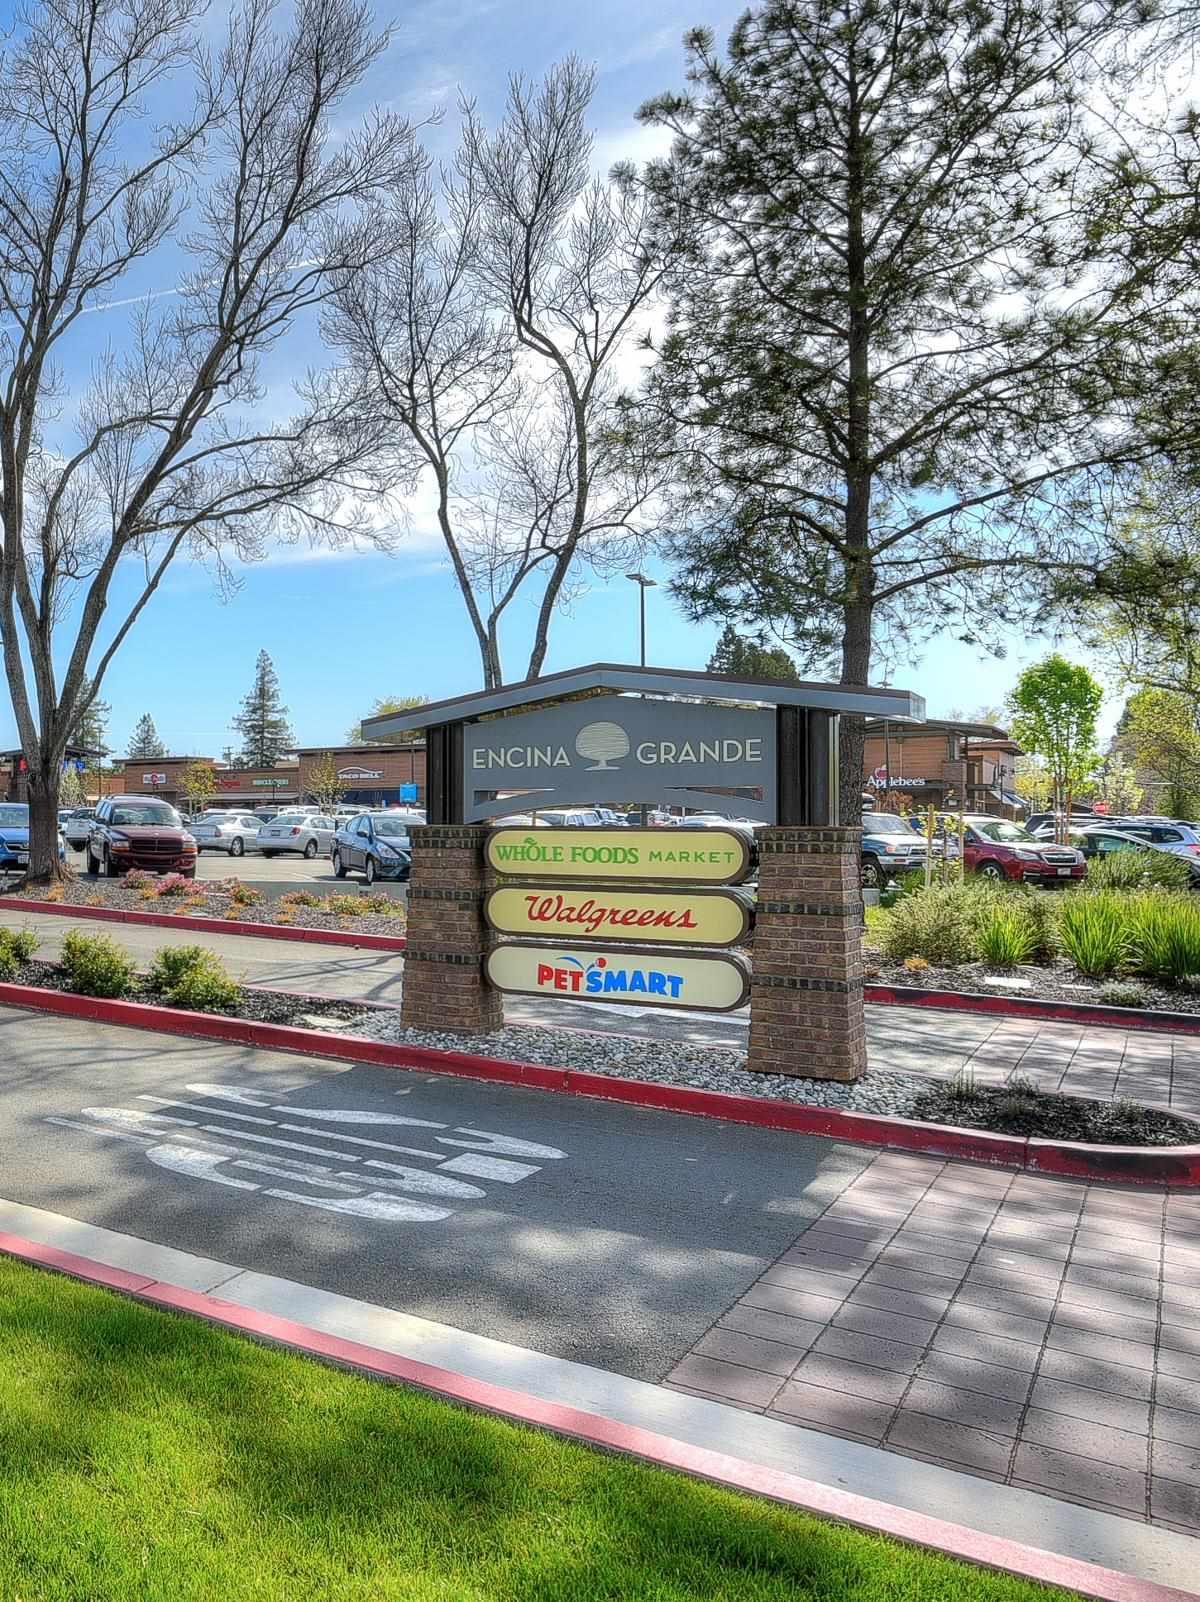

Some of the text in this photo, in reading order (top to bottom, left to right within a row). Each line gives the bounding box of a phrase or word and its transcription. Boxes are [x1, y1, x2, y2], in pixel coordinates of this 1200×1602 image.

[472, 738, 763, 769] ENCINA GRANDE
[495, 838, 735, 865] WHOLE FOODS MARKET
[524, 895, 698, 933] Walgreens
